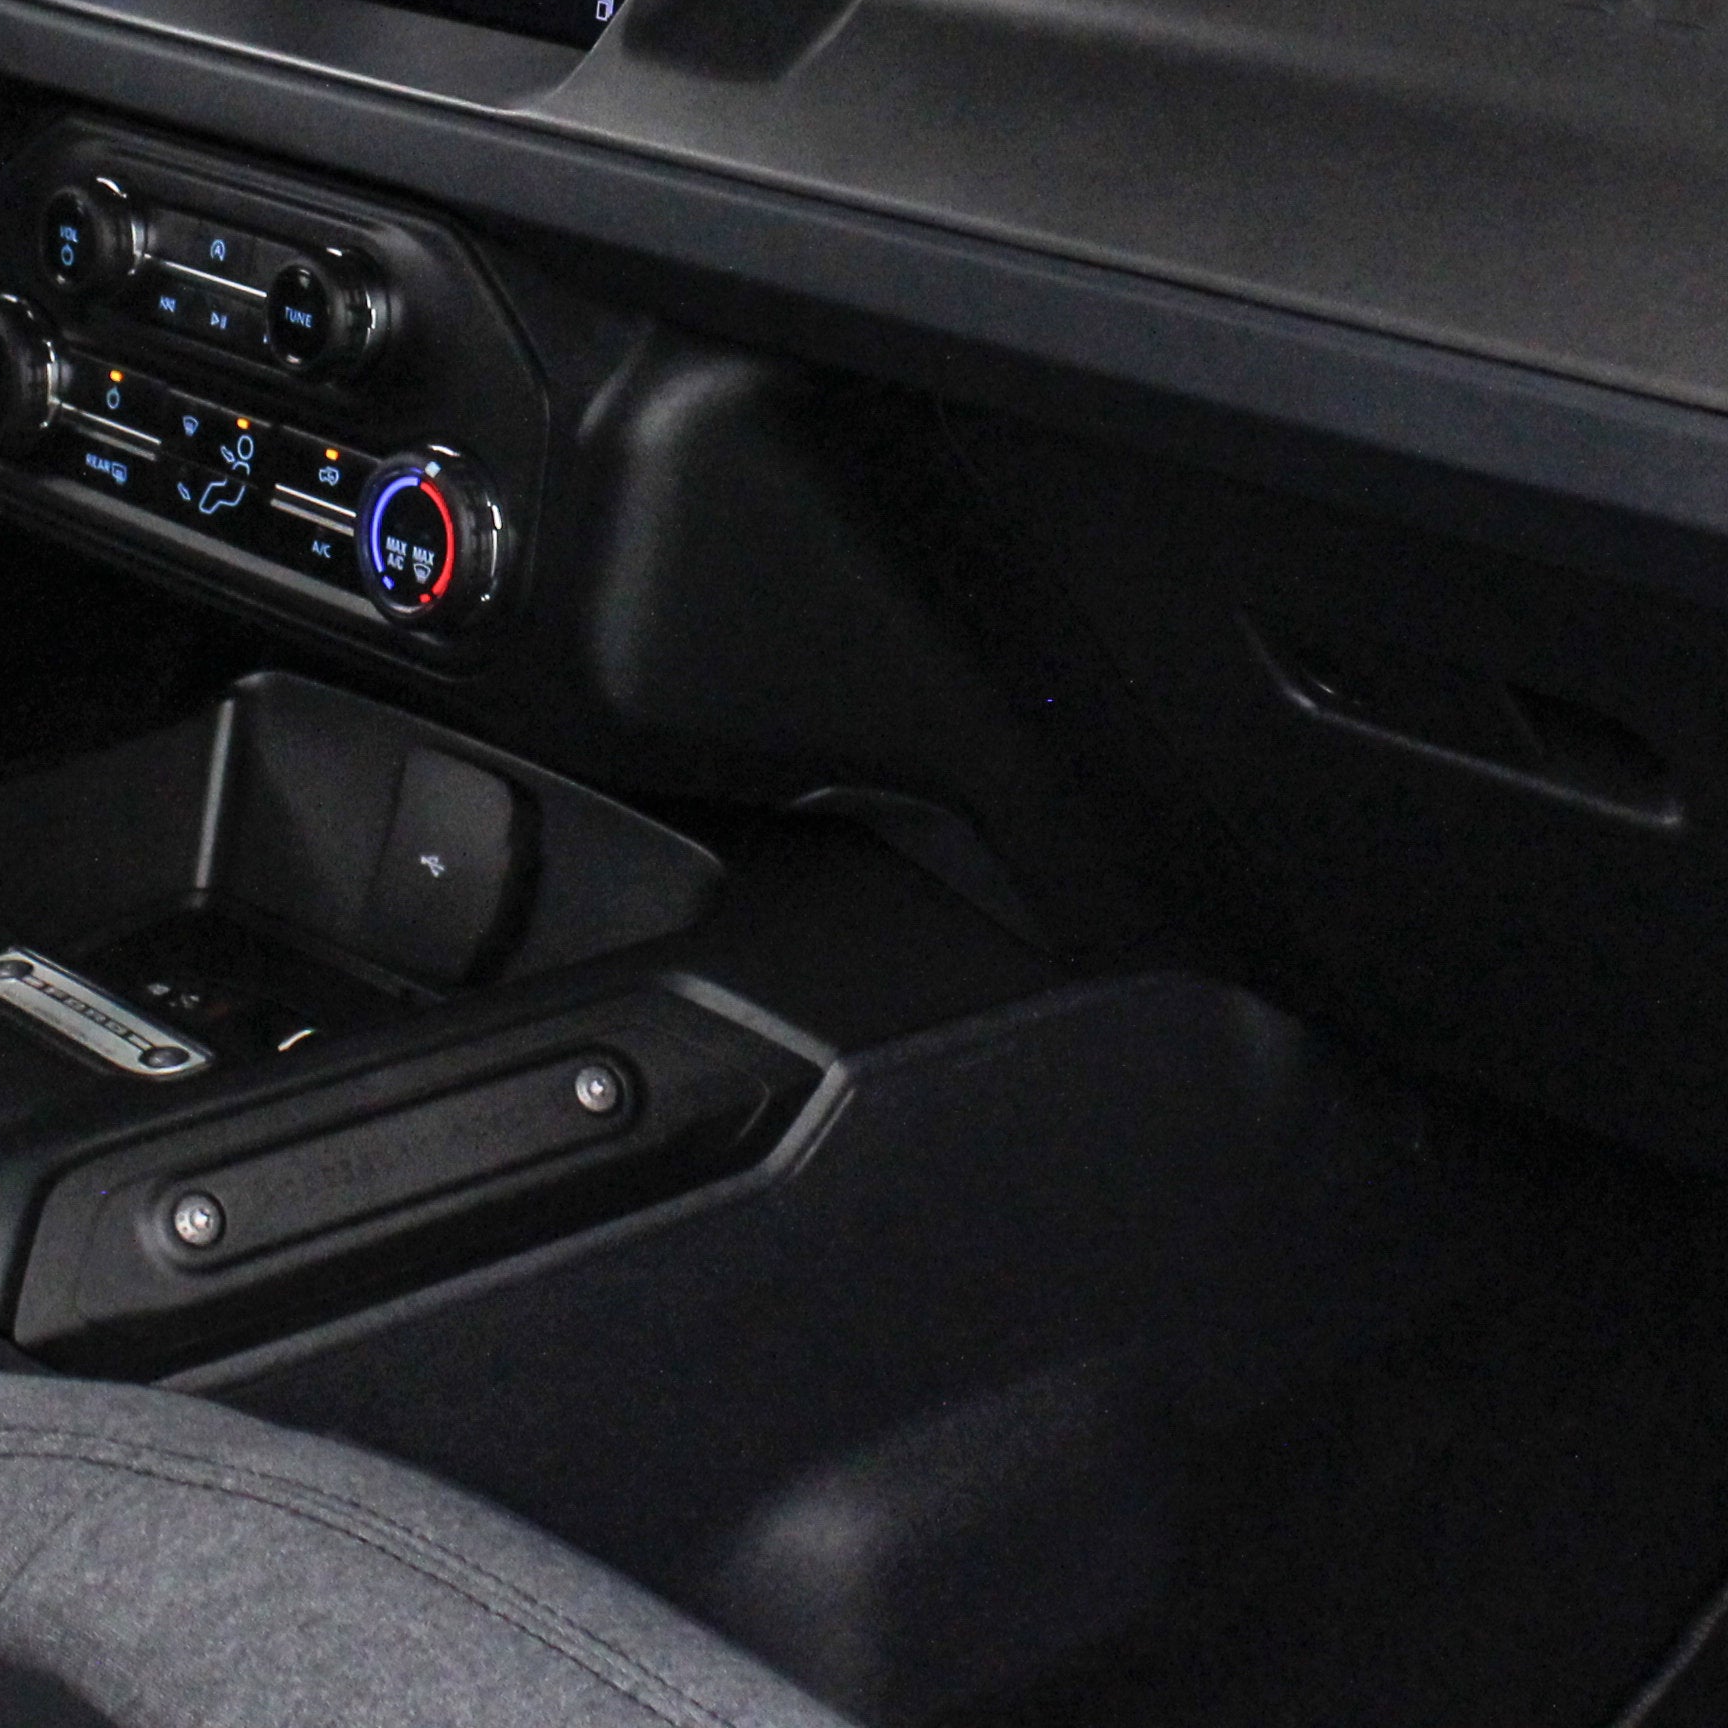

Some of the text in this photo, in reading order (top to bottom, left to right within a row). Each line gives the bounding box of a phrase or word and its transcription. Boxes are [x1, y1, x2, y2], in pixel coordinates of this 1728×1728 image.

[285, 306, 313, 328] TUNE
[85, 453, 111, 473] REAR
[311, 540, 331, 559] A/C
[385, 536, 407, 557] MAX
[412, 546, 435, 566] MAX
[387, 554, 404, 571] A/C
